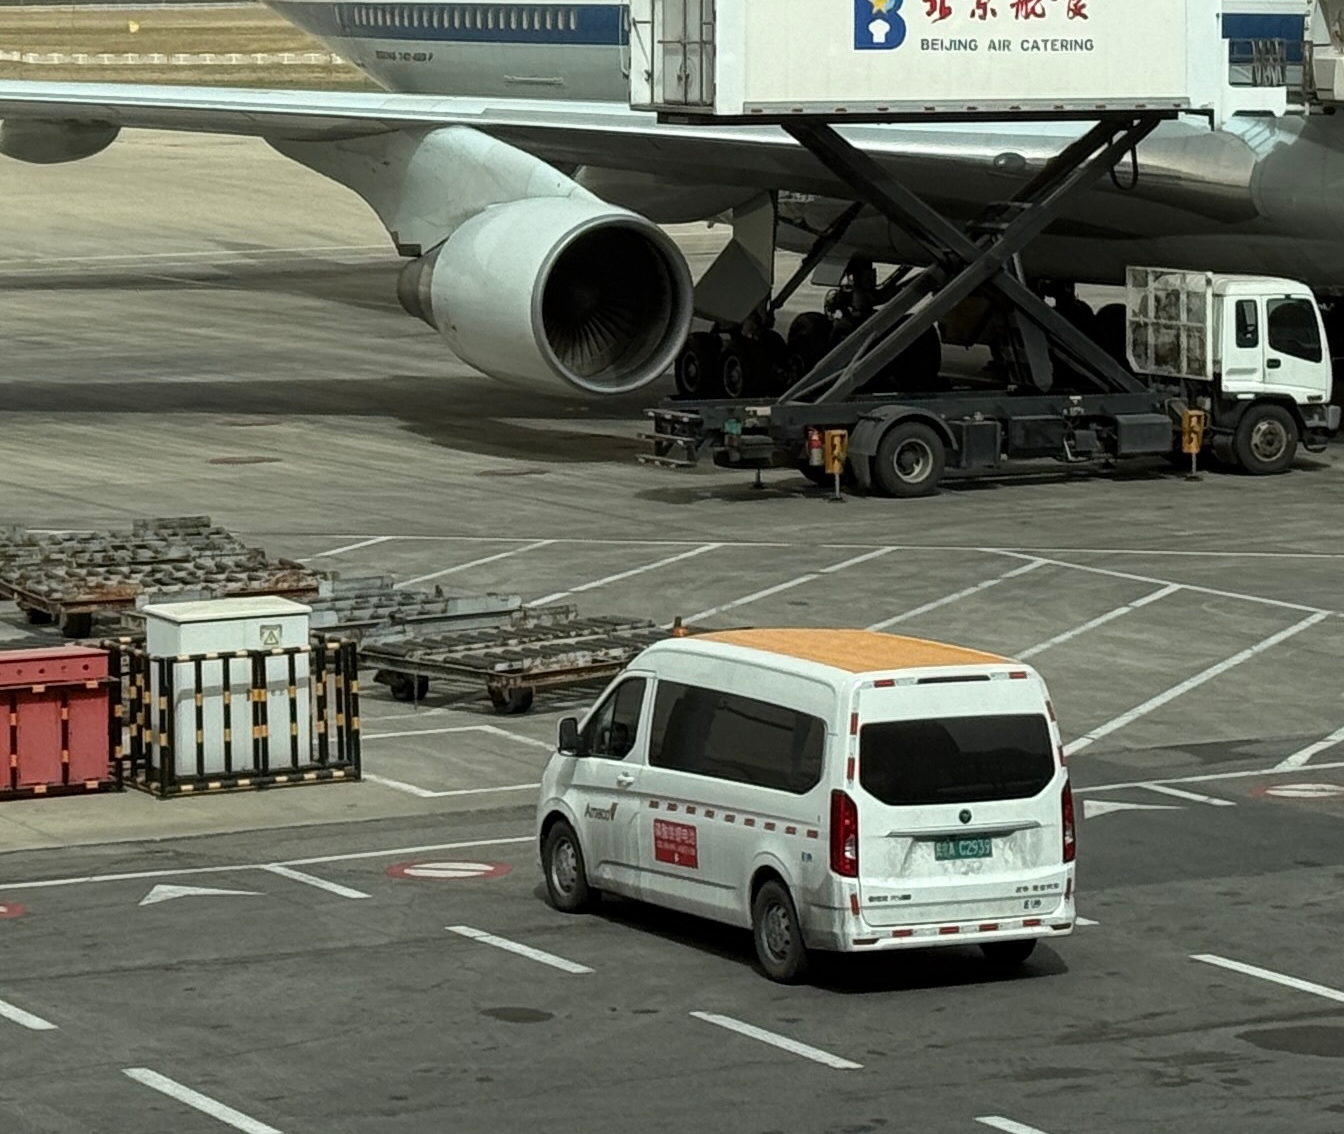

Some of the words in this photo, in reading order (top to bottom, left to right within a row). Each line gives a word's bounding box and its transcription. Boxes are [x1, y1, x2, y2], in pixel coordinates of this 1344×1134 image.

[920, 38, 979, 52] BEIJING
[987, 38, 1012, 52] AIR
[1020, 38, 1095, 52] CATERING
